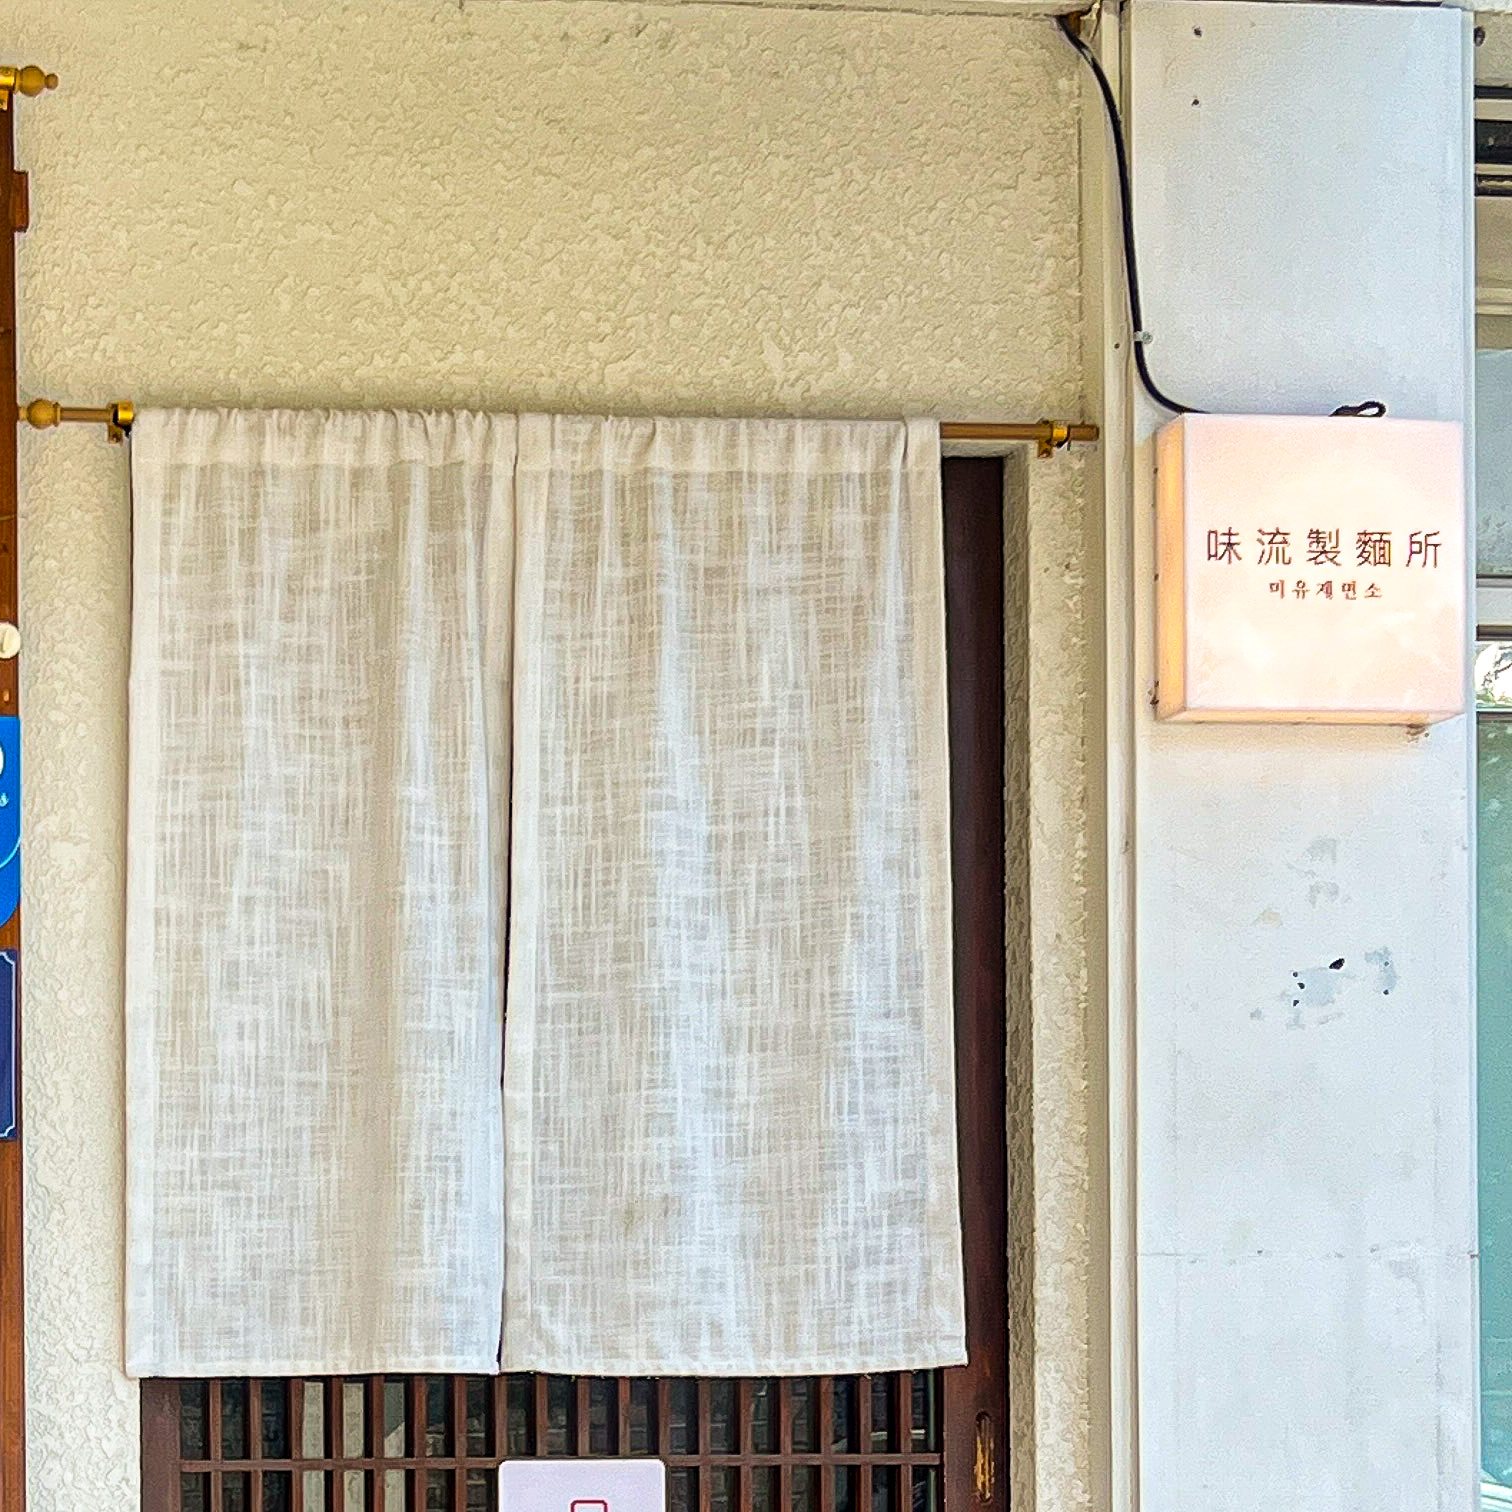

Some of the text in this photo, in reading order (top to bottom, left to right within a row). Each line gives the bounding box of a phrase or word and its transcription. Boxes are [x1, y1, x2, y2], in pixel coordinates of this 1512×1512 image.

[1206, 527, 1442, 568] 味流製麵所
[1268, 579, 1383, 601] 미유제면소
